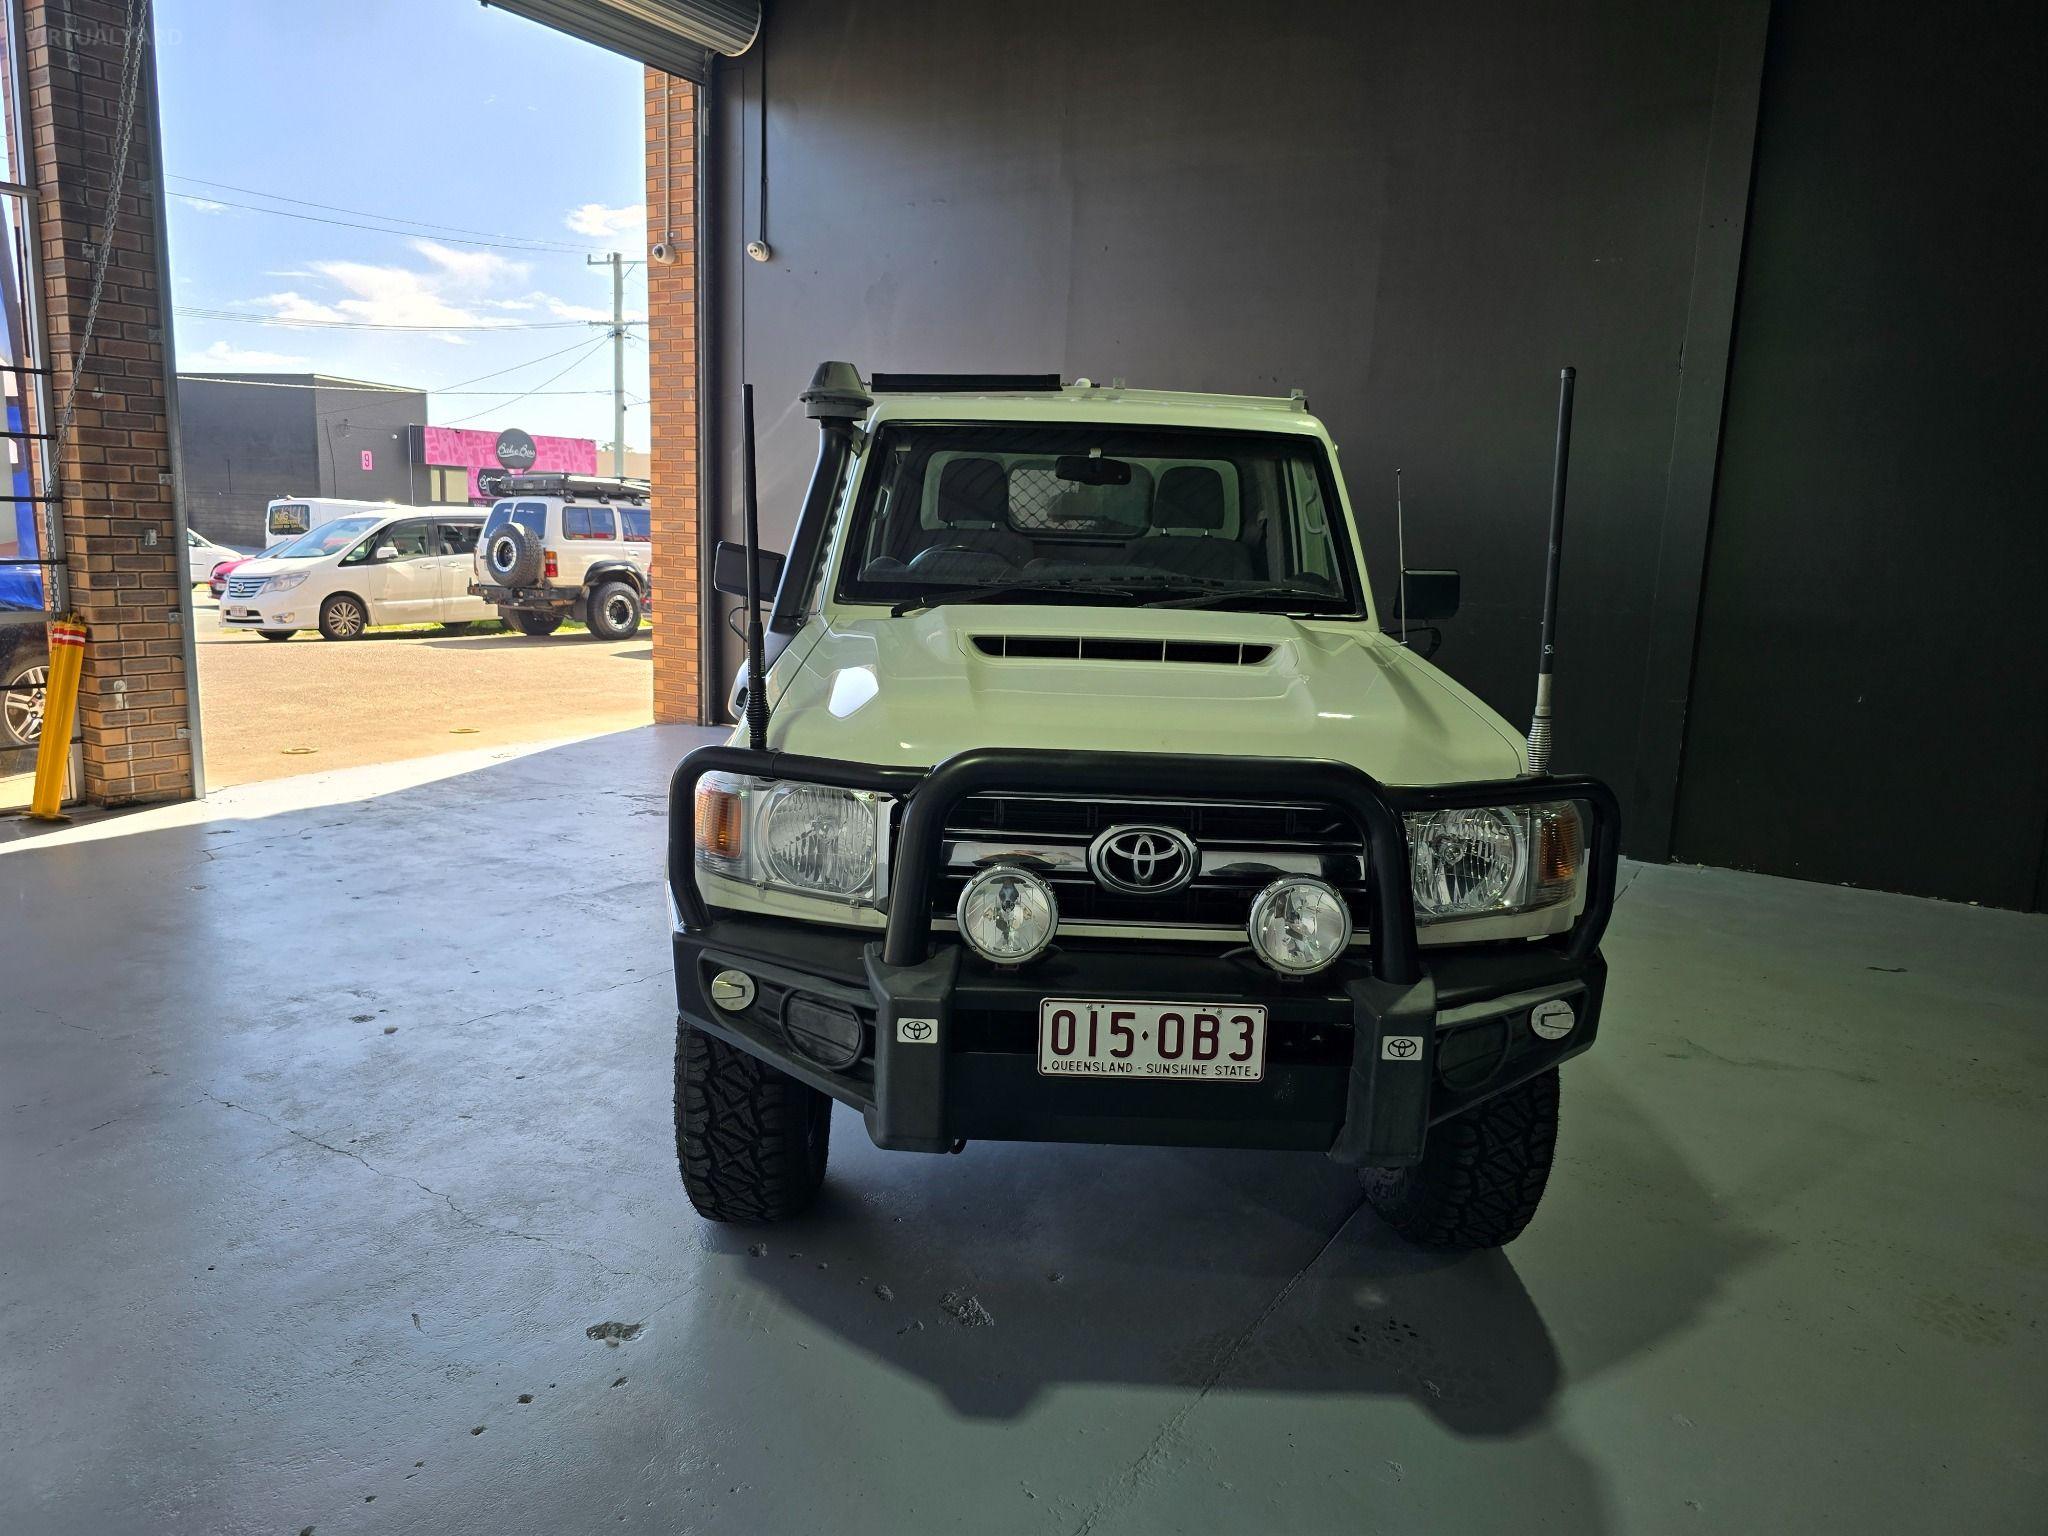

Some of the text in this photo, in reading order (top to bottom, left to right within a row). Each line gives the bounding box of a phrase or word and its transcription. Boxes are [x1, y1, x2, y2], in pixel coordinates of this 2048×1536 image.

[364, 453, 370, 468] 9
[1051, 1060, 1133, 1073] QUEENSLAND
[1146, 1063, 1207, 1075] SUNSHINE
[1214, 1065, 1251, 1077] STATE
